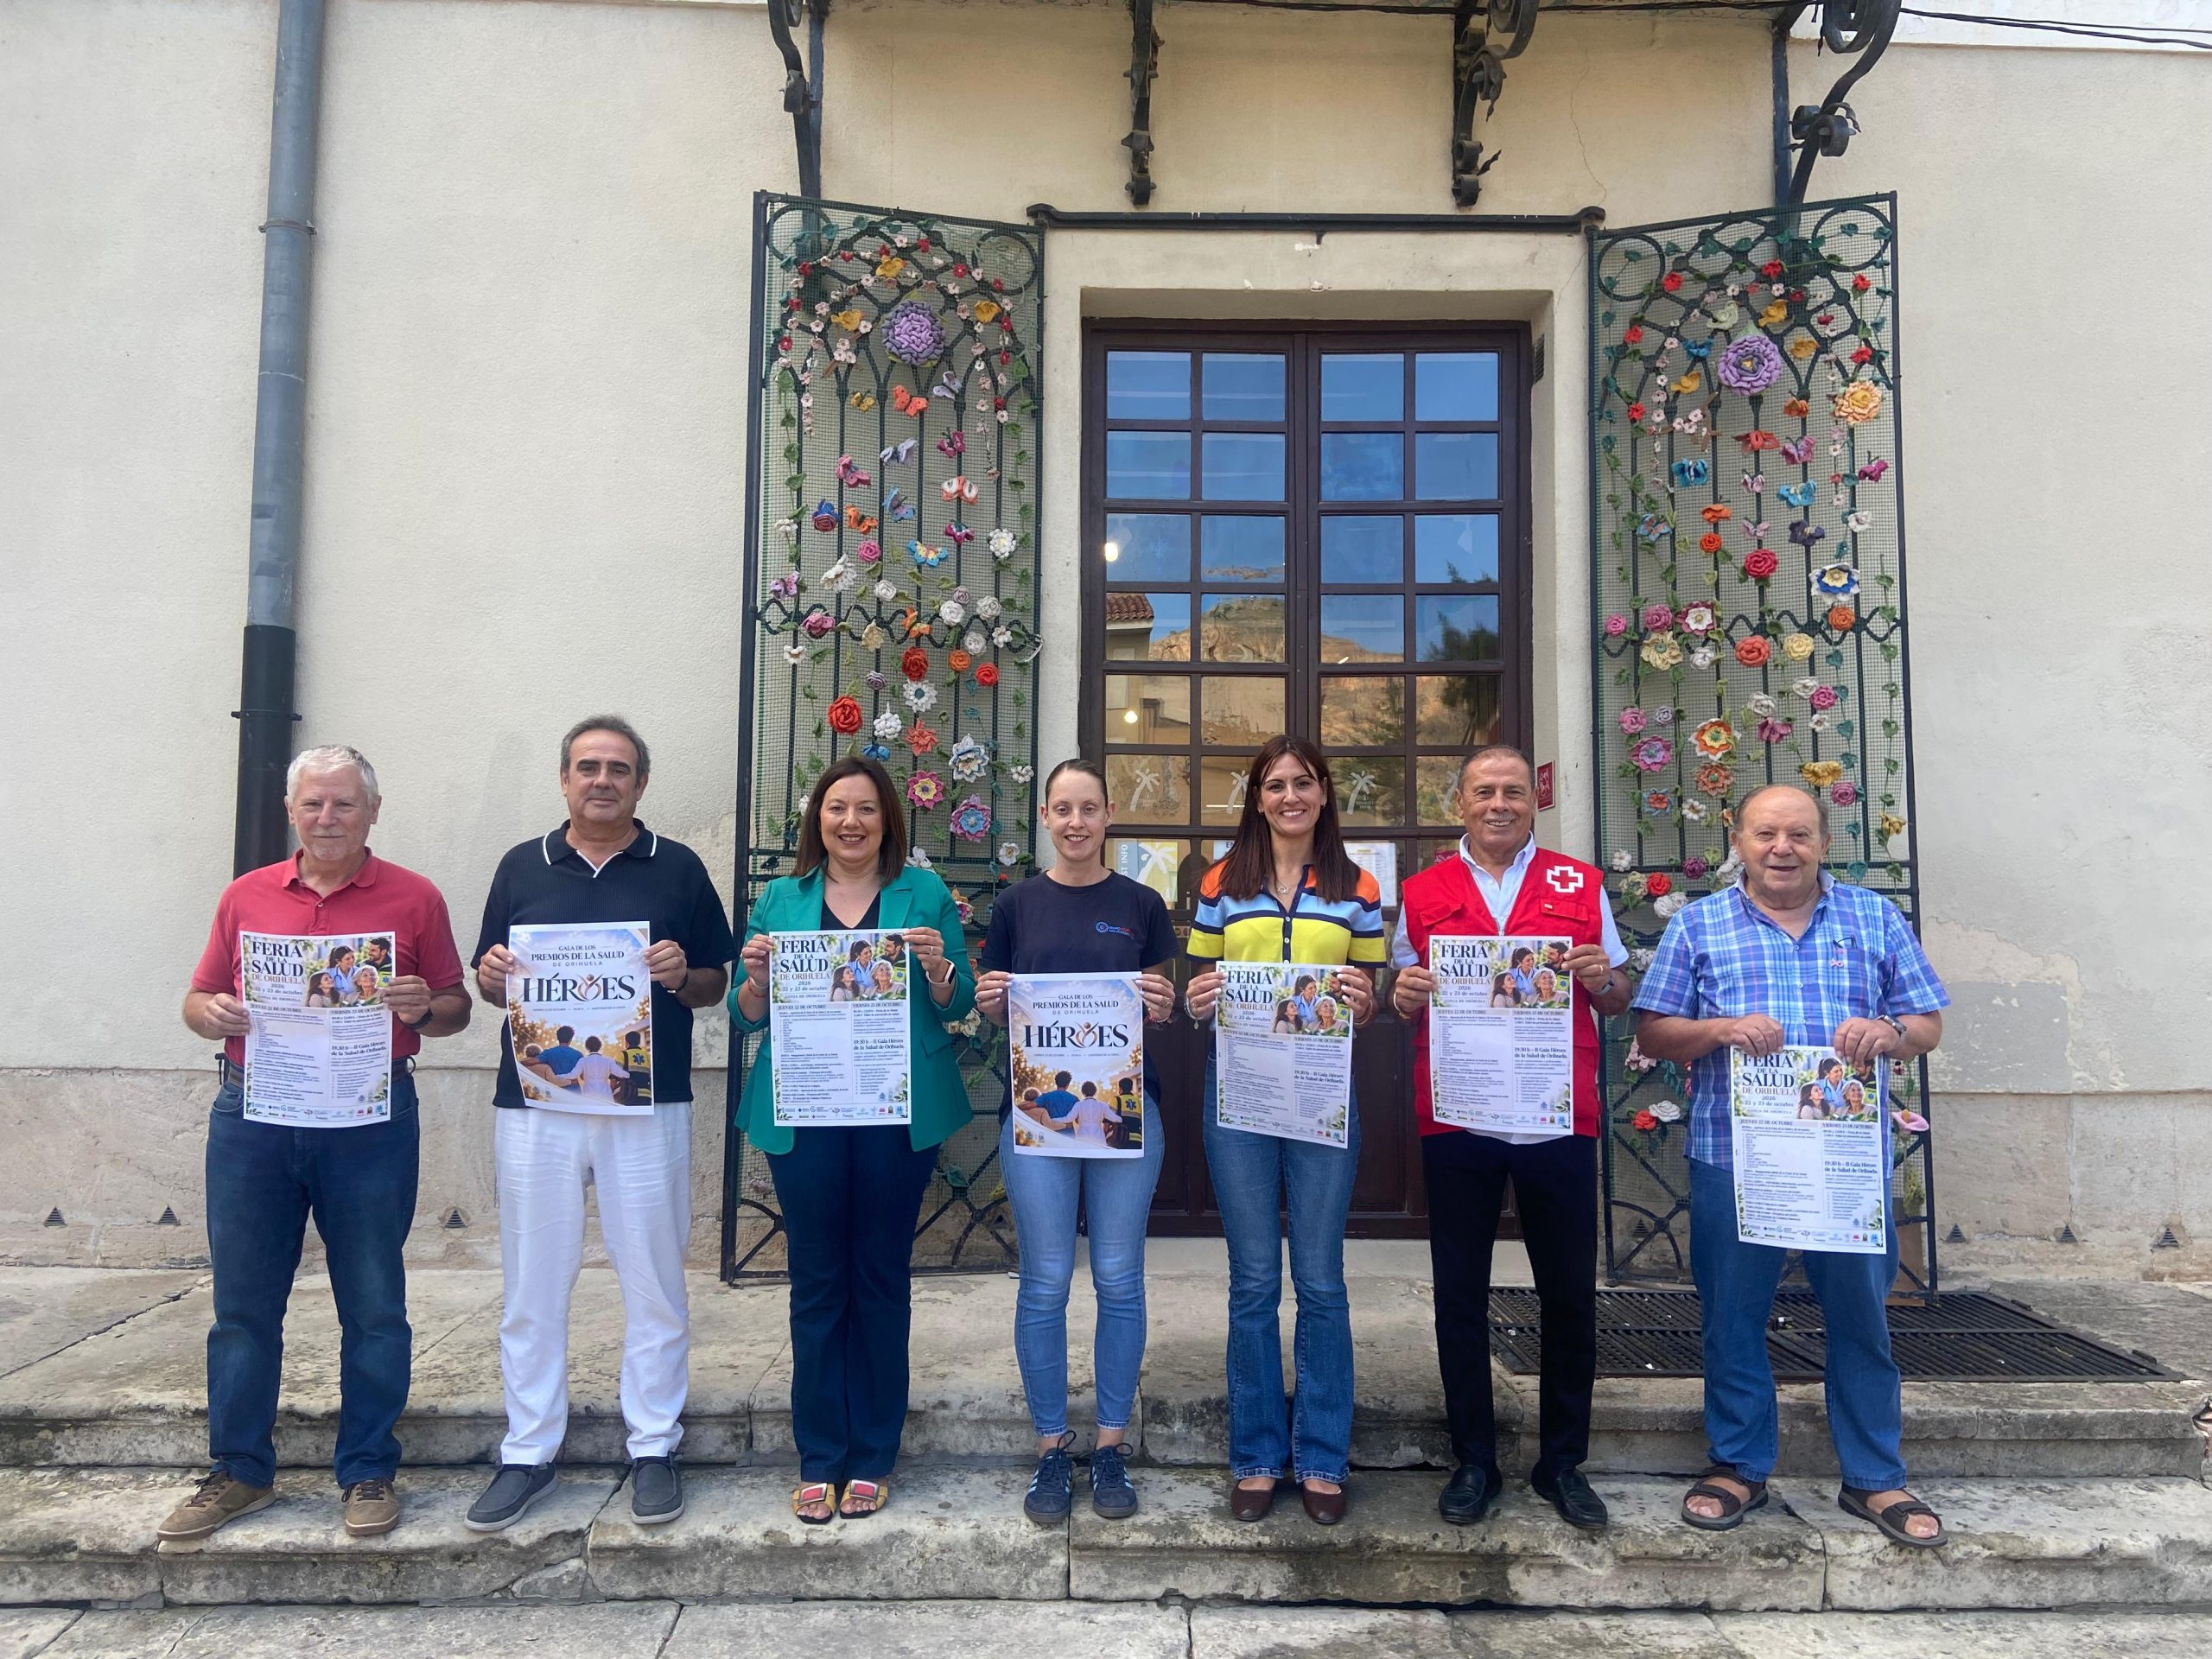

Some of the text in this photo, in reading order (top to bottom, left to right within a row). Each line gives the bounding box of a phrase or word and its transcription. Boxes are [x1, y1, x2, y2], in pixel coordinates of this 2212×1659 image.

[251, 941, 303, 957] FERIA
[781, 940, 828, 953] FERIA
[1440, 945, 1488, 957] FERIA
[598, 950, 625, 960] SALUD
[251, 960, 303, 976] SALUD
[780, 959, 829, 973] SALUD
[1440, 964, 1489, 977] SALUD
[264, 975, 306, 984] ORIHUELA
[1227, 970, 1273, 984] FERIA
[1225, 989, 1273, 1004] SALUD
[1742, 1053, 1793, 1068] FERIA
[1742, 1073, 1795, 1088] SALUD
[1755, 1087, 1796, 1096] ORIHUELA
